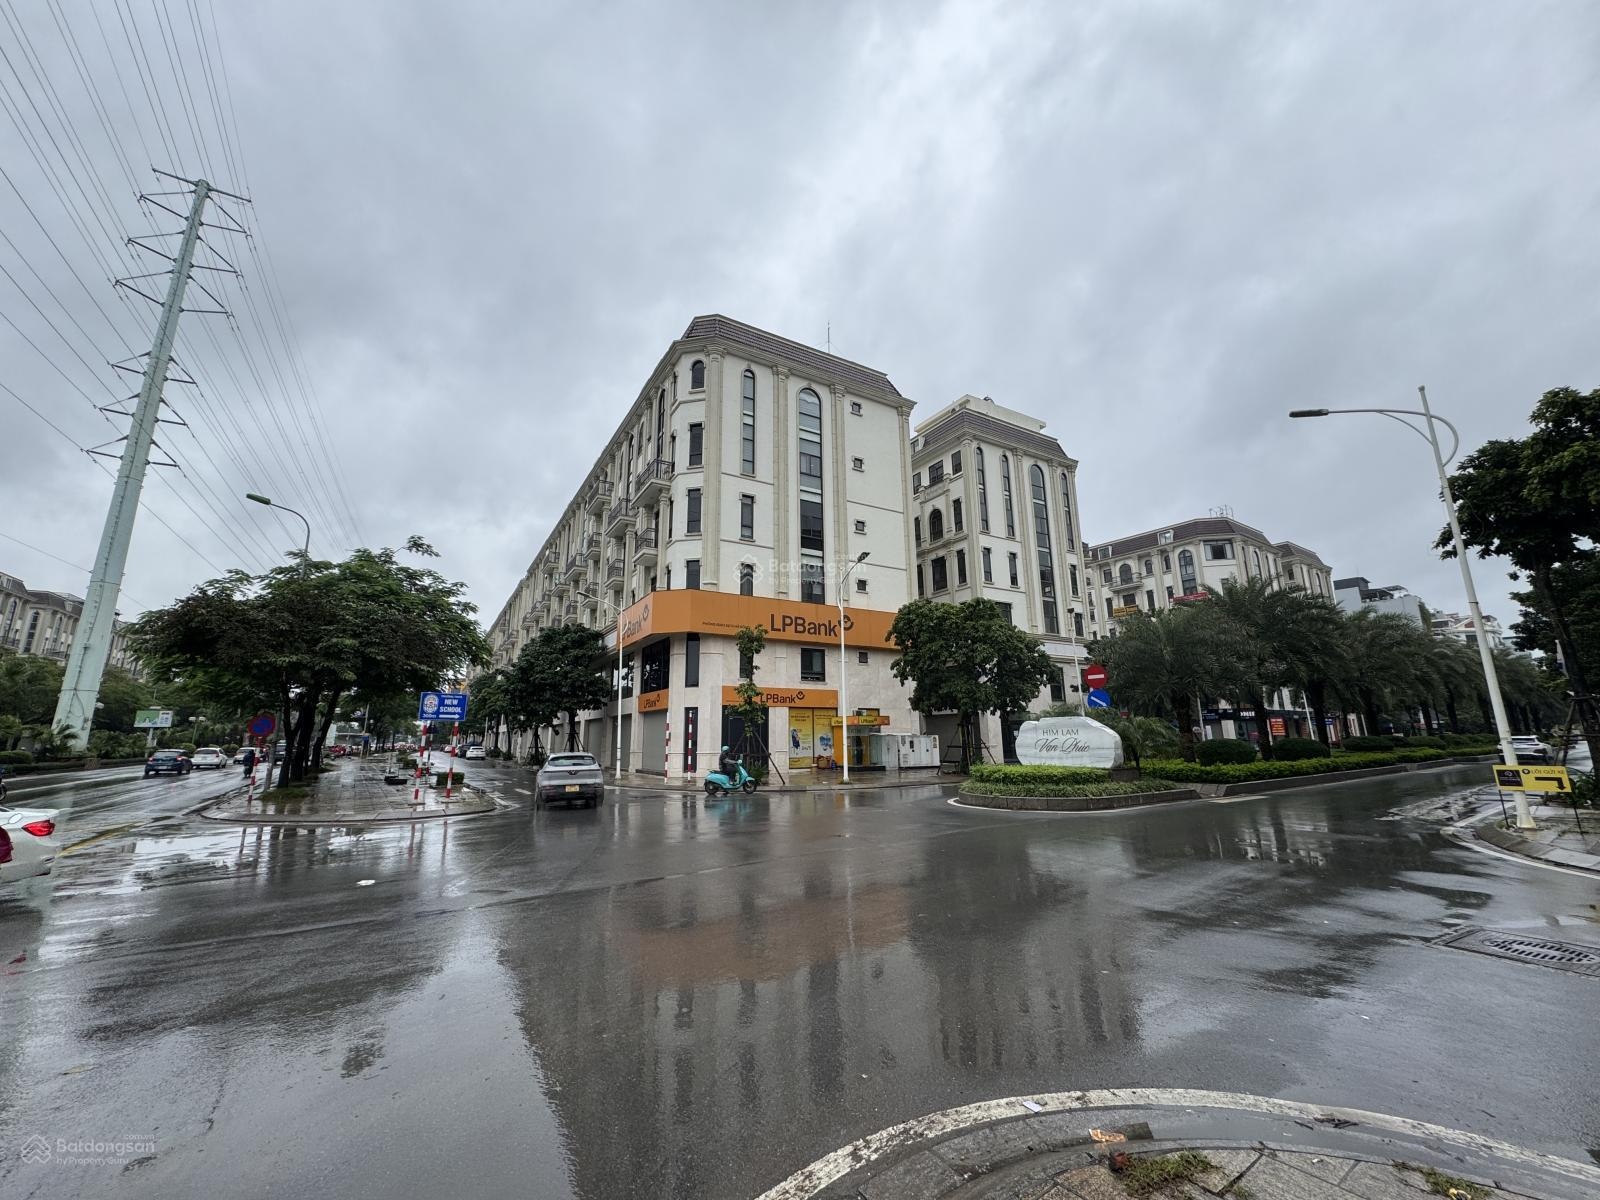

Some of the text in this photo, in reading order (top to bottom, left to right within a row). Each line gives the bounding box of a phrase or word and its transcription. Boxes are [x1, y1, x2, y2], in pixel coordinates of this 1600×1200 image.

[770, 613, 838, 637] LPBank
[760, 693, 796, 704] LPBank
[1042, 728, 1079, 736] HIM LAM
